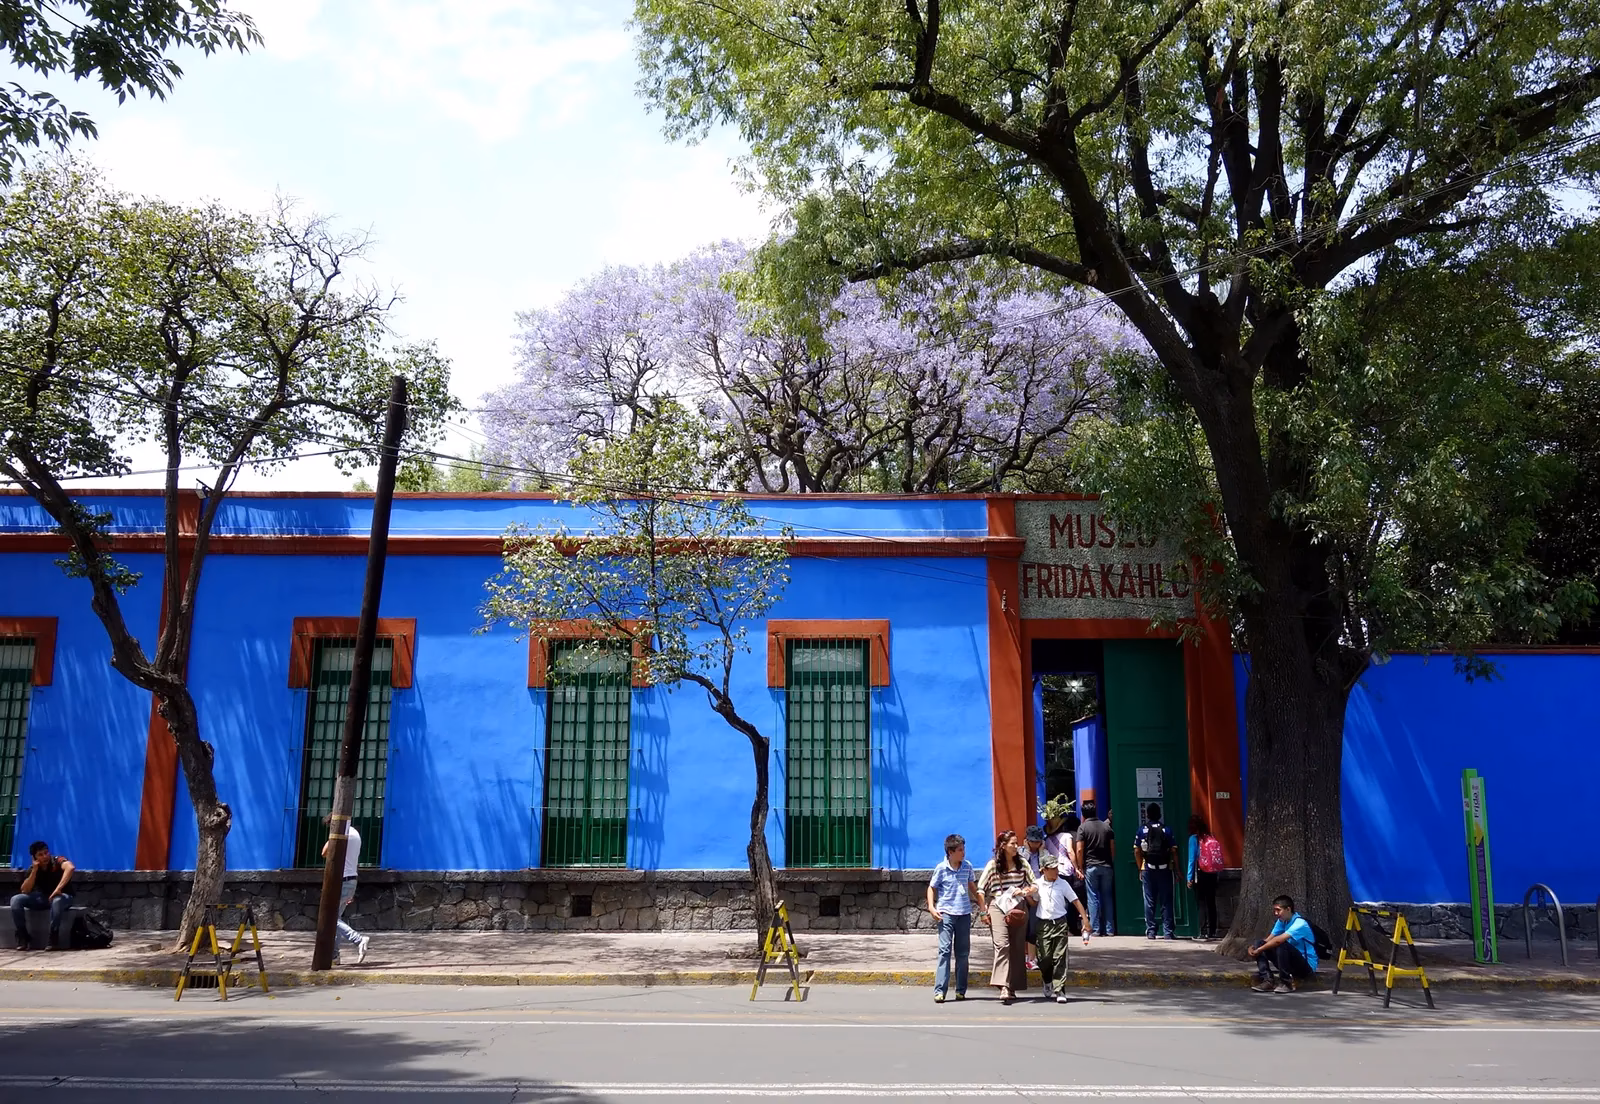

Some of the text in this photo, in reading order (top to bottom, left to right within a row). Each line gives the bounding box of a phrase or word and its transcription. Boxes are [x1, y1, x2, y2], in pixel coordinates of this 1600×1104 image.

[1050, 513, 1157, 549] MUSO
[1022, 562, 1190, 599] FRIDA KAHLO
